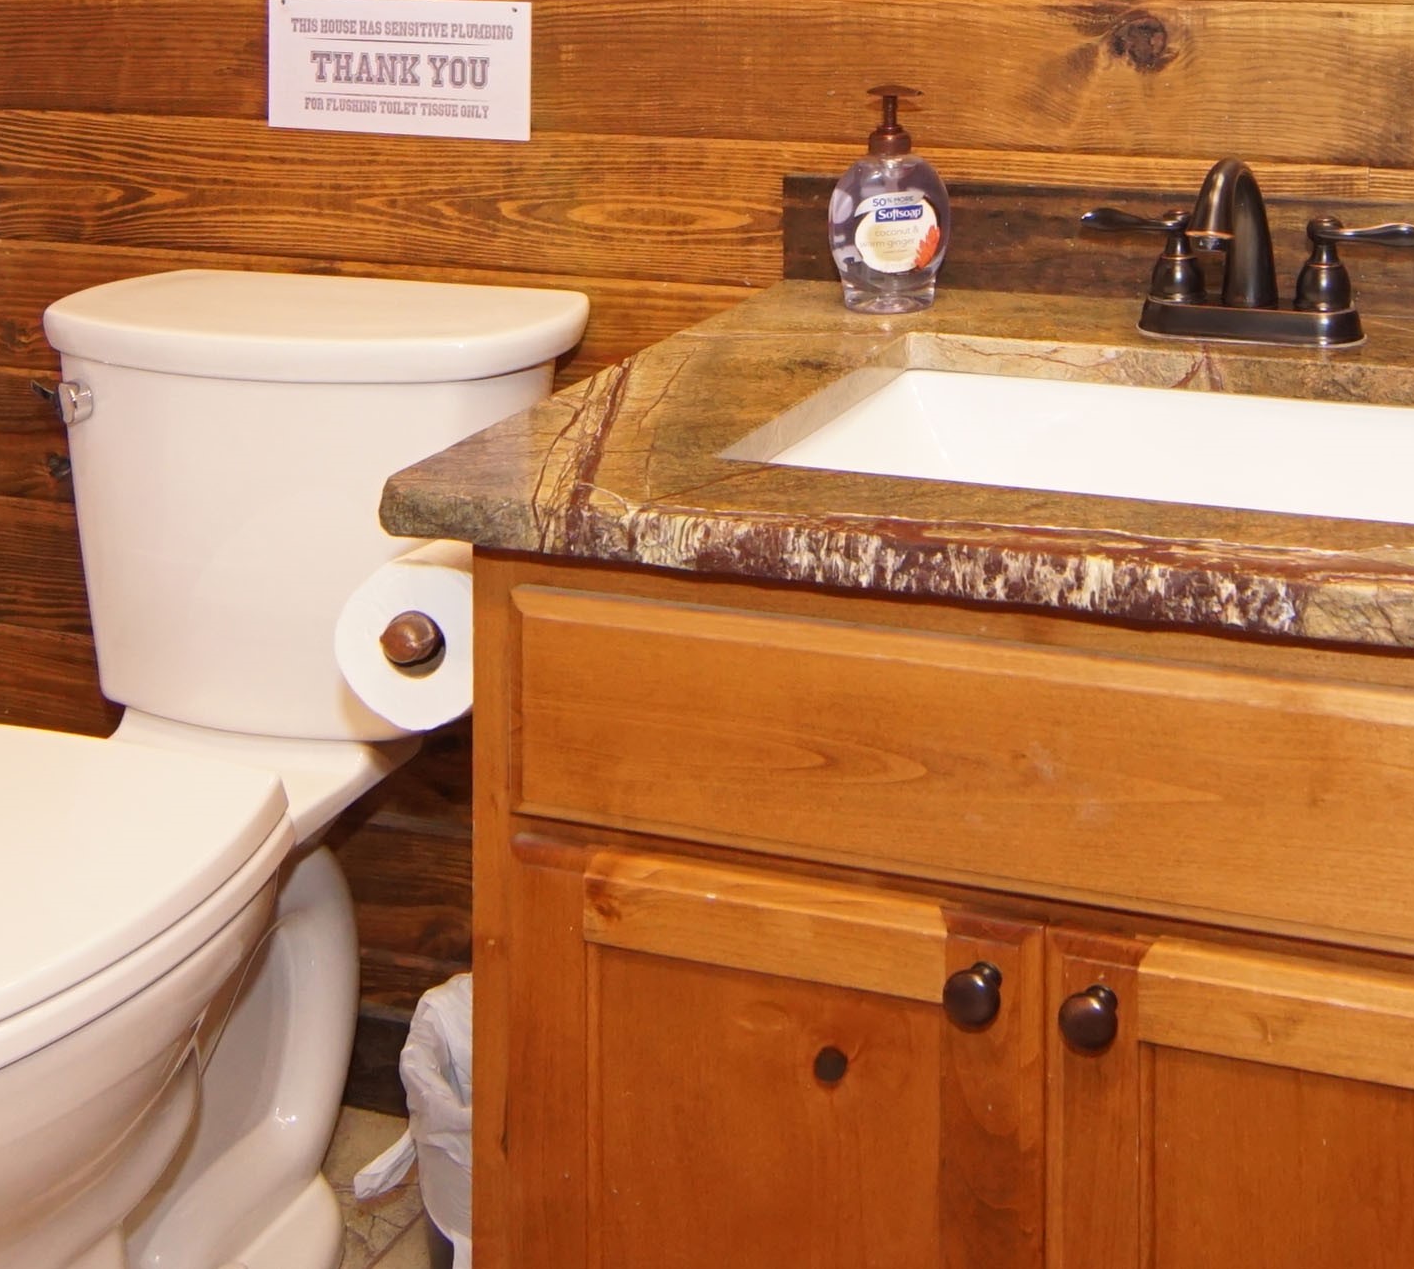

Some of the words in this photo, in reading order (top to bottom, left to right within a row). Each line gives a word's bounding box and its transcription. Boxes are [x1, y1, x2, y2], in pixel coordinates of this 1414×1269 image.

[291, 17, 318, 34] THIS
[320, 19, 357, 36] HOUSE
[359, 20, 382, 36] HAS
[384, 21, 449, 39] SENSITIVE
[450, 24, 513, 41] PLUMBING
[310, 50, 421, 87] THANK
[426, 54, 490, 90] YOU
[304, 96, 325, 111] FOR
[326, 97, 377, 113] FLUSHING
[379, 100, 418, 116] TOILET
[421, 102, 459, 118] TISSUE
[460, 105, 489, 120] ONLY
[877, 208, 922, 221] Softsoap
